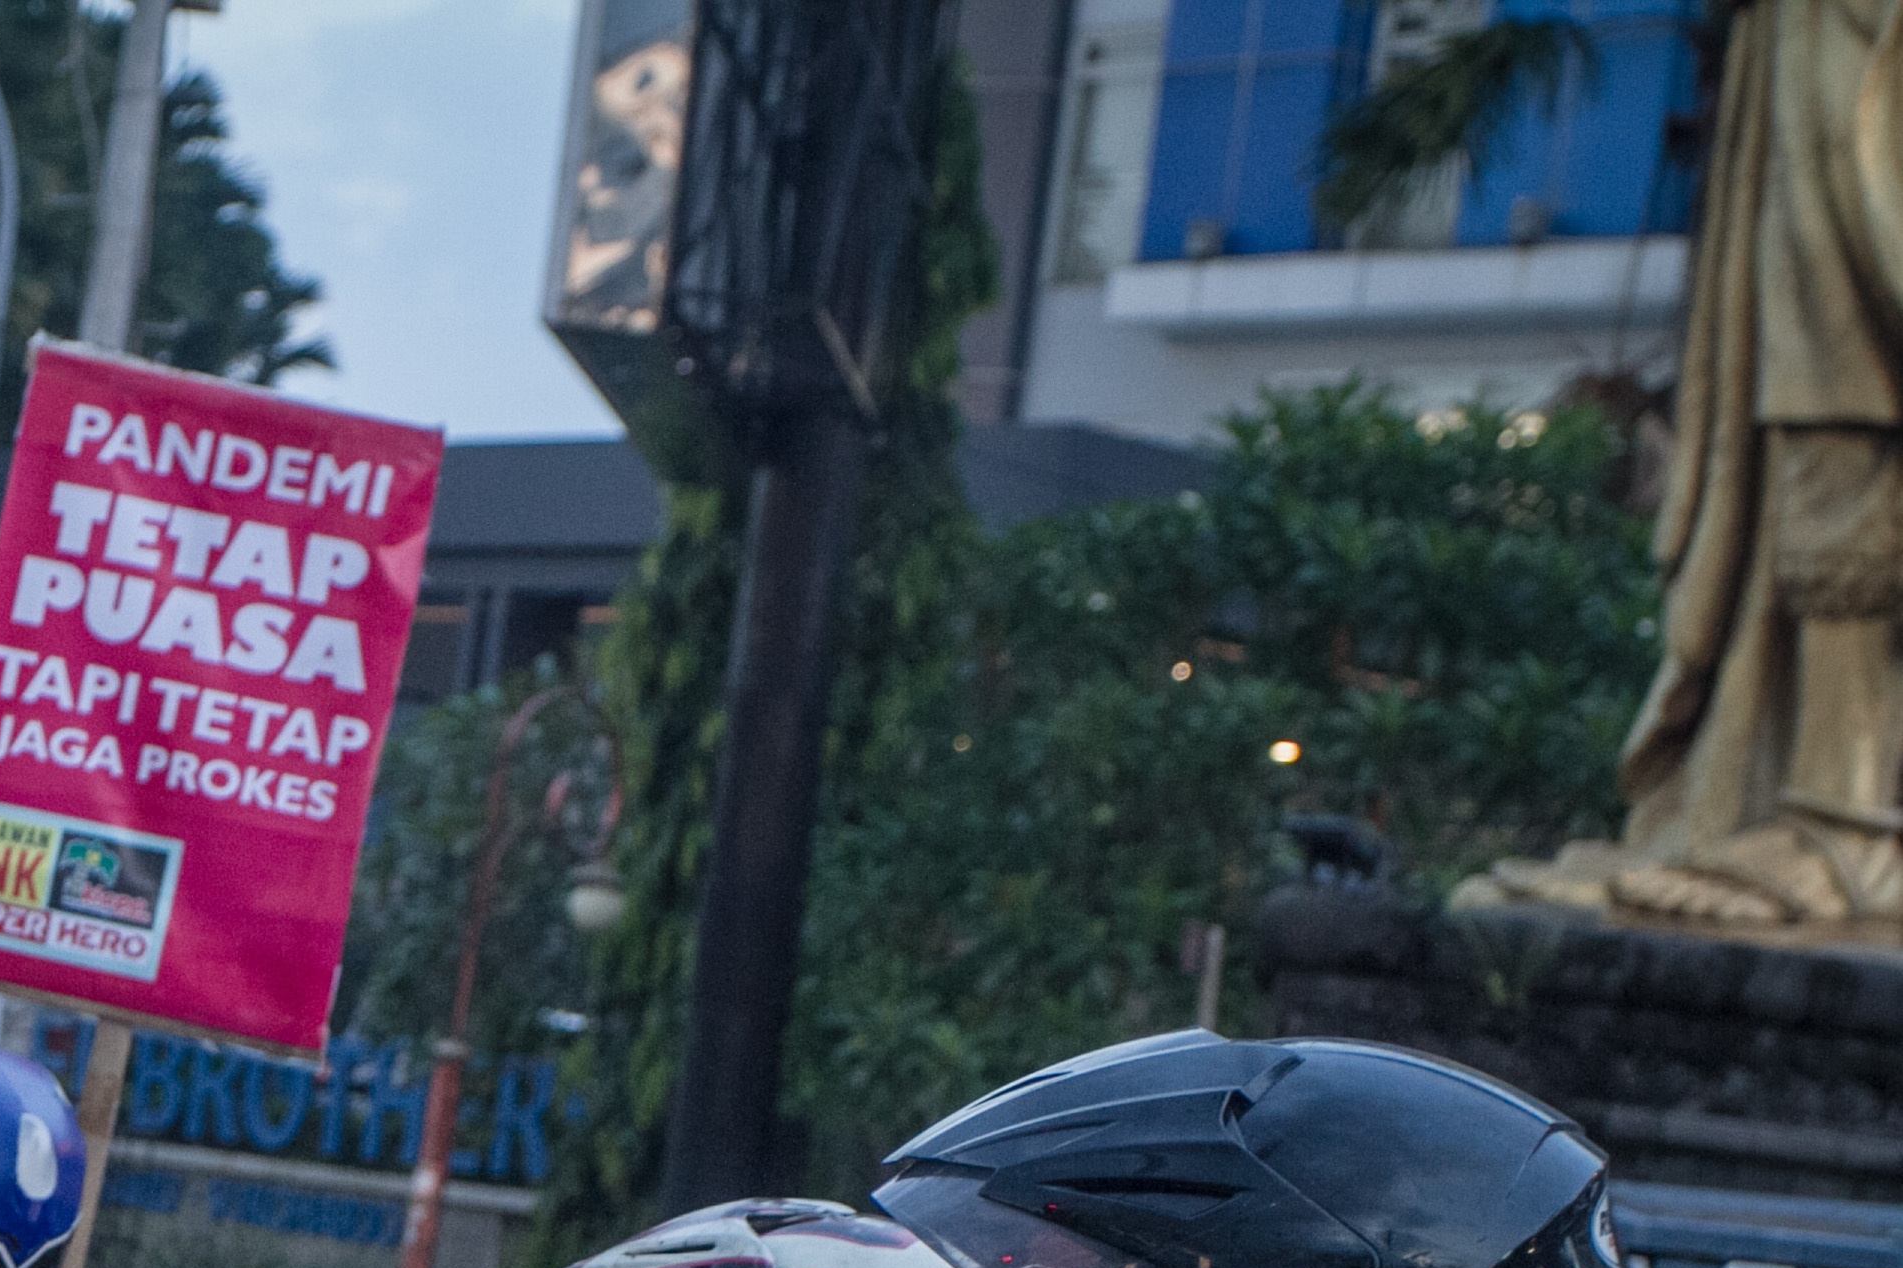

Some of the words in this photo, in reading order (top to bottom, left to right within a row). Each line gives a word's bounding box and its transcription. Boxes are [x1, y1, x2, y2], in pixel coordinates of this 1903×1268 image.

[64, 403, 394, 517] PANDEMI
[50, 482, 369, 605] TETAP
[10, 555, 367, 694] PUASA
[150, 676, 370, 766] TETAP
[137, 746, 338, 821] PROKES
[56, 917, 147, 959] HERO
